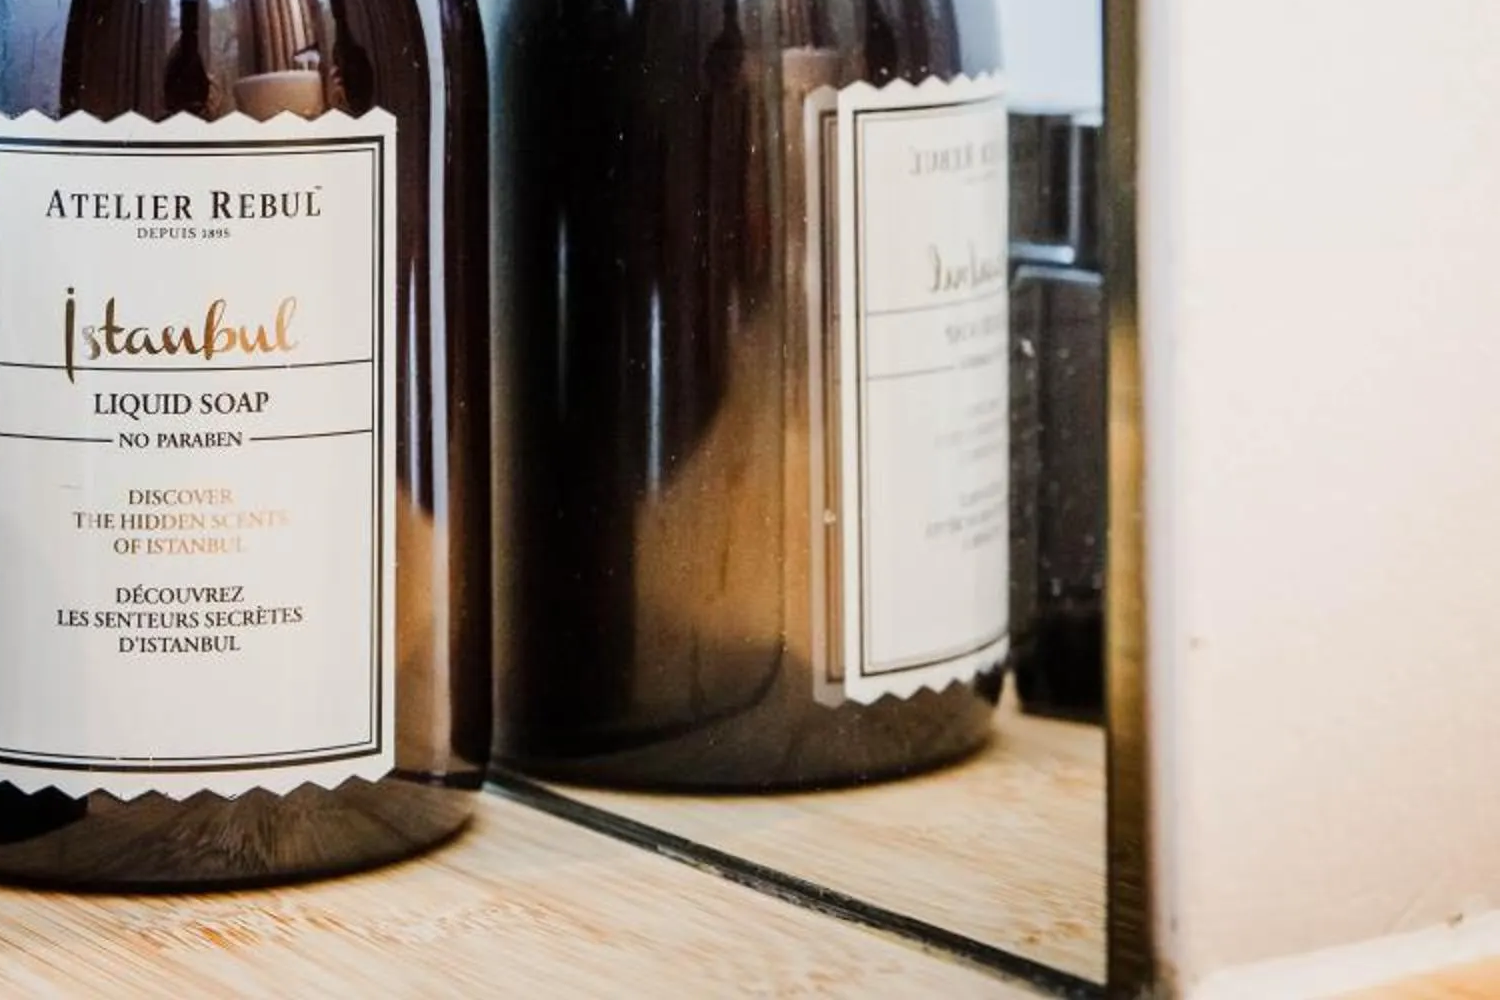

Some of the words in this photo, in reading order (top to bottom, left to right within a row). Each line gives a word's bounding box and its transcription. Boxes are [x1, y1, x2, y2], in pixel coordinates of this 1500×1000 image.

[45, 189, 193, 221] ATELIER
[211, 189, 322, 220] REBUL
[136, 227, 197, 240] DEPUIS
[201, 228, 231, 239] 1895
[94, 392, 192, 420] LIQUID
[201, 391, 269, 415] SOAP
[119, 433, 149, 449] NO
[157, 431, 243, 449] PARABEN
[128, 488, 234, 507] DISCOVER
[73, 511, 115, 531] THE
[121, 513, 207, 531] HIDDEN
[211, 509, 291, 530] SCENTS
[114, 538, 142, 555] OF
[147, 537, 248, 555] ISTANBUL
[116, 584, 245, 605] DÉCOUVREZ
[56, 609, 89, 627] LES
[93, 611, 200, 629] SENTEURS
[204, 606, 304, 627] SECRÈTES
[118, 635, 241, 653] D'ISTANBUL
